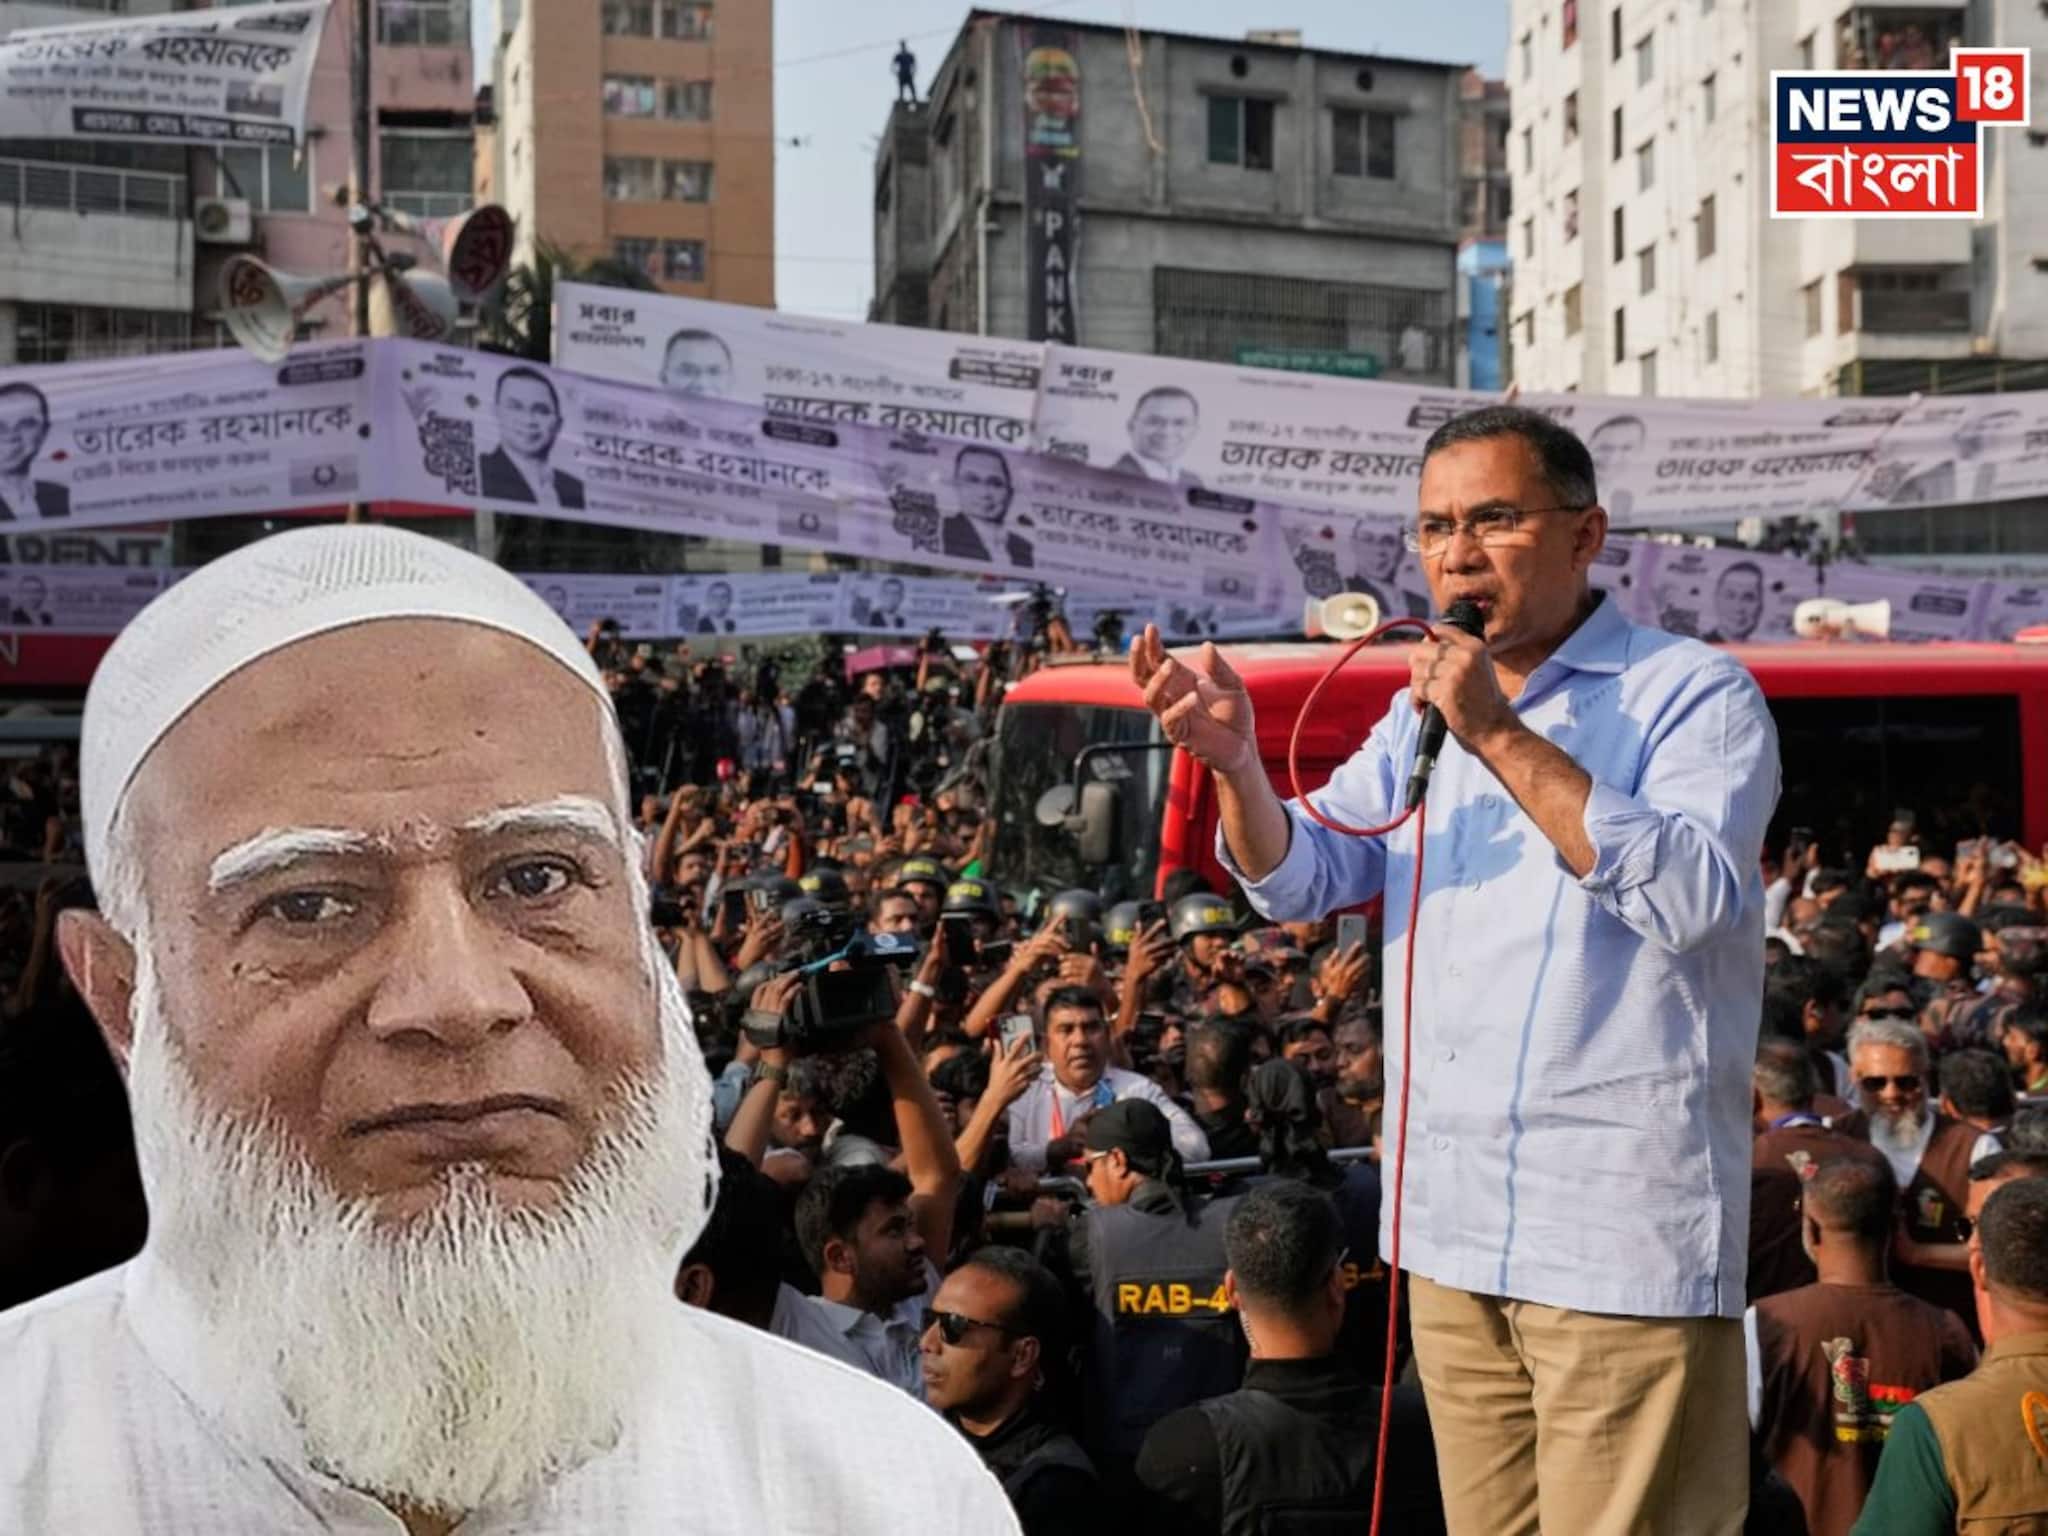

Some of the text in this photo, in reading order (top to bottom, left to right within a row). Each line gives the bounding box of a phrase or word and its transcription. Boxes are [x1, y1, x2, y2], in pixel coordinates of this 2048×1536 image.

[72, 419, 188, 455] তারেক
[199, 403, 352, 444] রহমানকে
[879, 402, 1025, 443] রহমানকে
[583, 431, 829, 489] তারেক রহমানকে
[1221, 441, 1424, 478] তারেক রহমান
[1118, 1283, 1231, 1315] RAB-4
